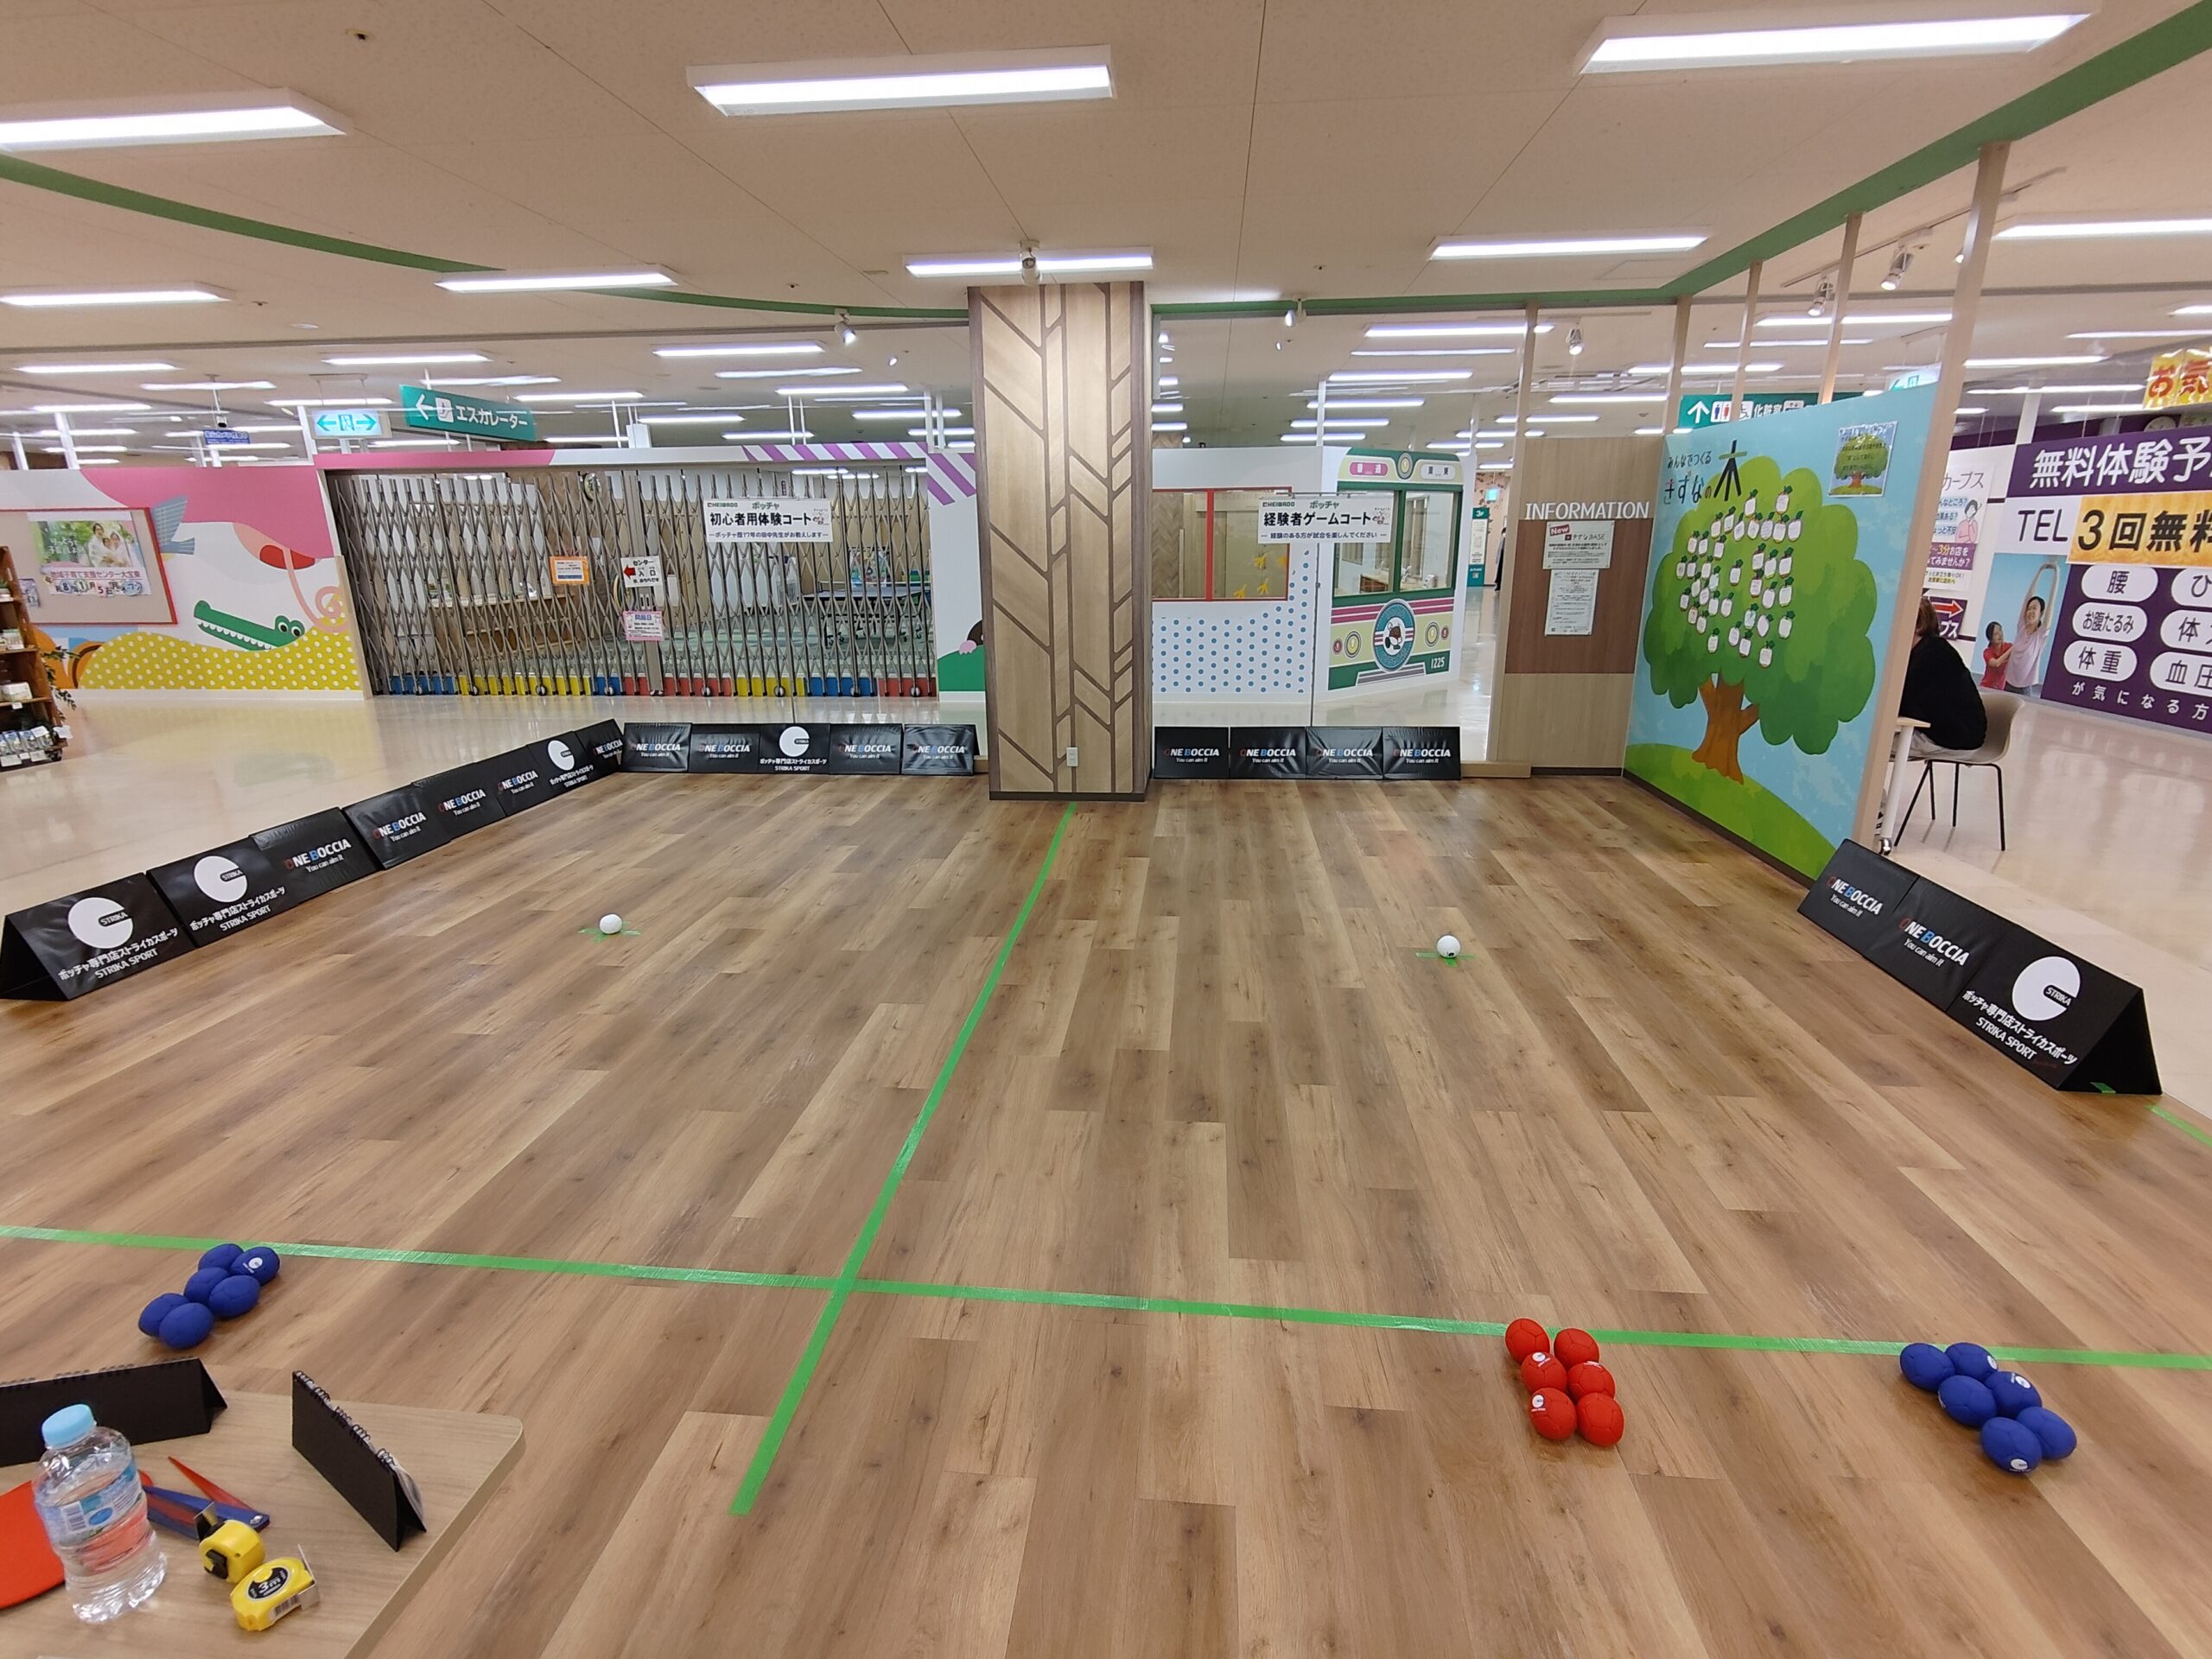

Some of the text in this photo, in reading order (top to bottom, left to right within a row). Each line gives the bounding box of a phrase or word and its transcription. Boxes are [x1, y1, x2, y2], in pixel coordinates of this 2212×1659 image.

[455, 404, 529, 429] エスカレーター
[1667, 450, 1713, 469] みんなでつくる
[2029, 435, 2212, 489] 無料体験予
[752, 501, 780, 510] ボッチャ
[1309, 500, 1340, 510] ボッチャ
[1525, 501, 1650, 520] INFORMATION
[709, 512, 812, 526] 初心者用体験コート
[1263, 512, 1372, 527] 経験者ゲームコート
[1550, 525, 1569, 536] New
[2018, 508, 2069, 543] TEL
[2107, 570, 2130, 594] 腰
[2082, 610, 2134, 635] お腹たるみ
[1430, 656, 1446, 670] 1225
[2078, 645, 2122, 675] 体重
[2071, 681, 2210, 721] が気になる方
[1260, 748, 1296, 757] BOCCIA
[455, 789, 486, 806] BOCCIA
[391, 812, 426, 831] BOCCIA
[308, 838, 351, 861] BOCCIA
[189, 886, 285, 931] ボッチャ専門店ストライカスポーツ
[1843, 886, 1885, 915] BOCCIA
[100, 912, 129, 925] STRIKA
[219, 904, 271, 931] STRIKA SPORT
[58, 927, 178, 981] ボッチャ専門店ストライカスポーツ
[1920, 930, 1970, 966] BOCCIA
[94, 948, 158, 979] STRIKA SPORT
[2045, 987, 2072, 1007] STRIKA
[1962, 990, 2078, 1065] ボッチャ専門店ストライカスポーツ
[1975, 1017, 2037, 1060] STRIKA SPORT
[257, 1577, 282, 1593] 3m
